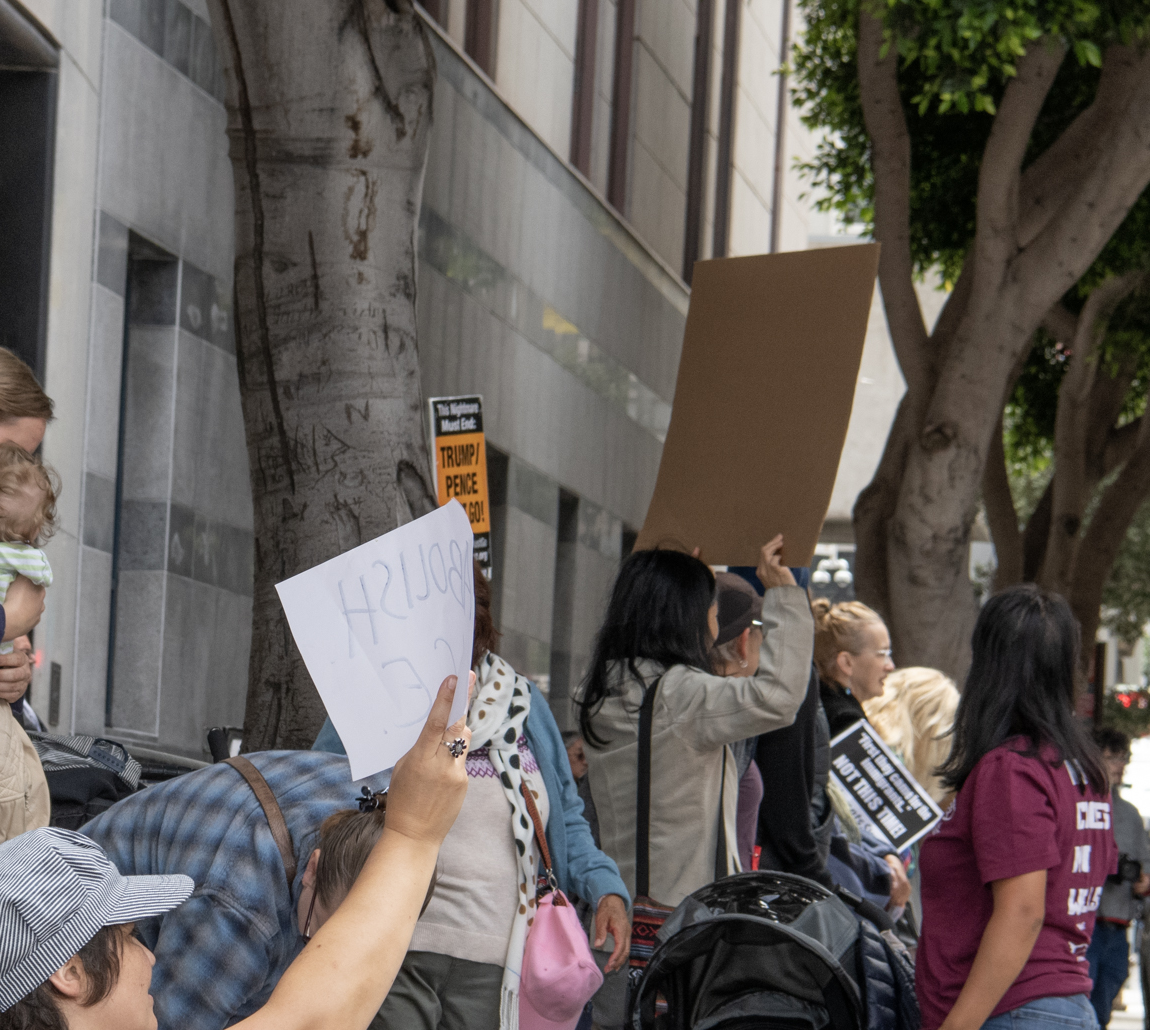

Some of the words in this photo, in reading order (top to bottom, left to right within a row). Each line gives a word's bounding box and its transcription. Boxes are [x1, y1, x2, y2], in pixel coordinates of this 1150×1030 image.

[437, 403, 450, 417] This
[441, 418, 460, 432] Must
[440, 443, 480, 469] TRUMP/
[445, 472, 478, 497] PENCE
[469, 501, 484, 523] GO!
[832, 753, 862, 783] NOT
[852, 775, 884, 812] THIS
